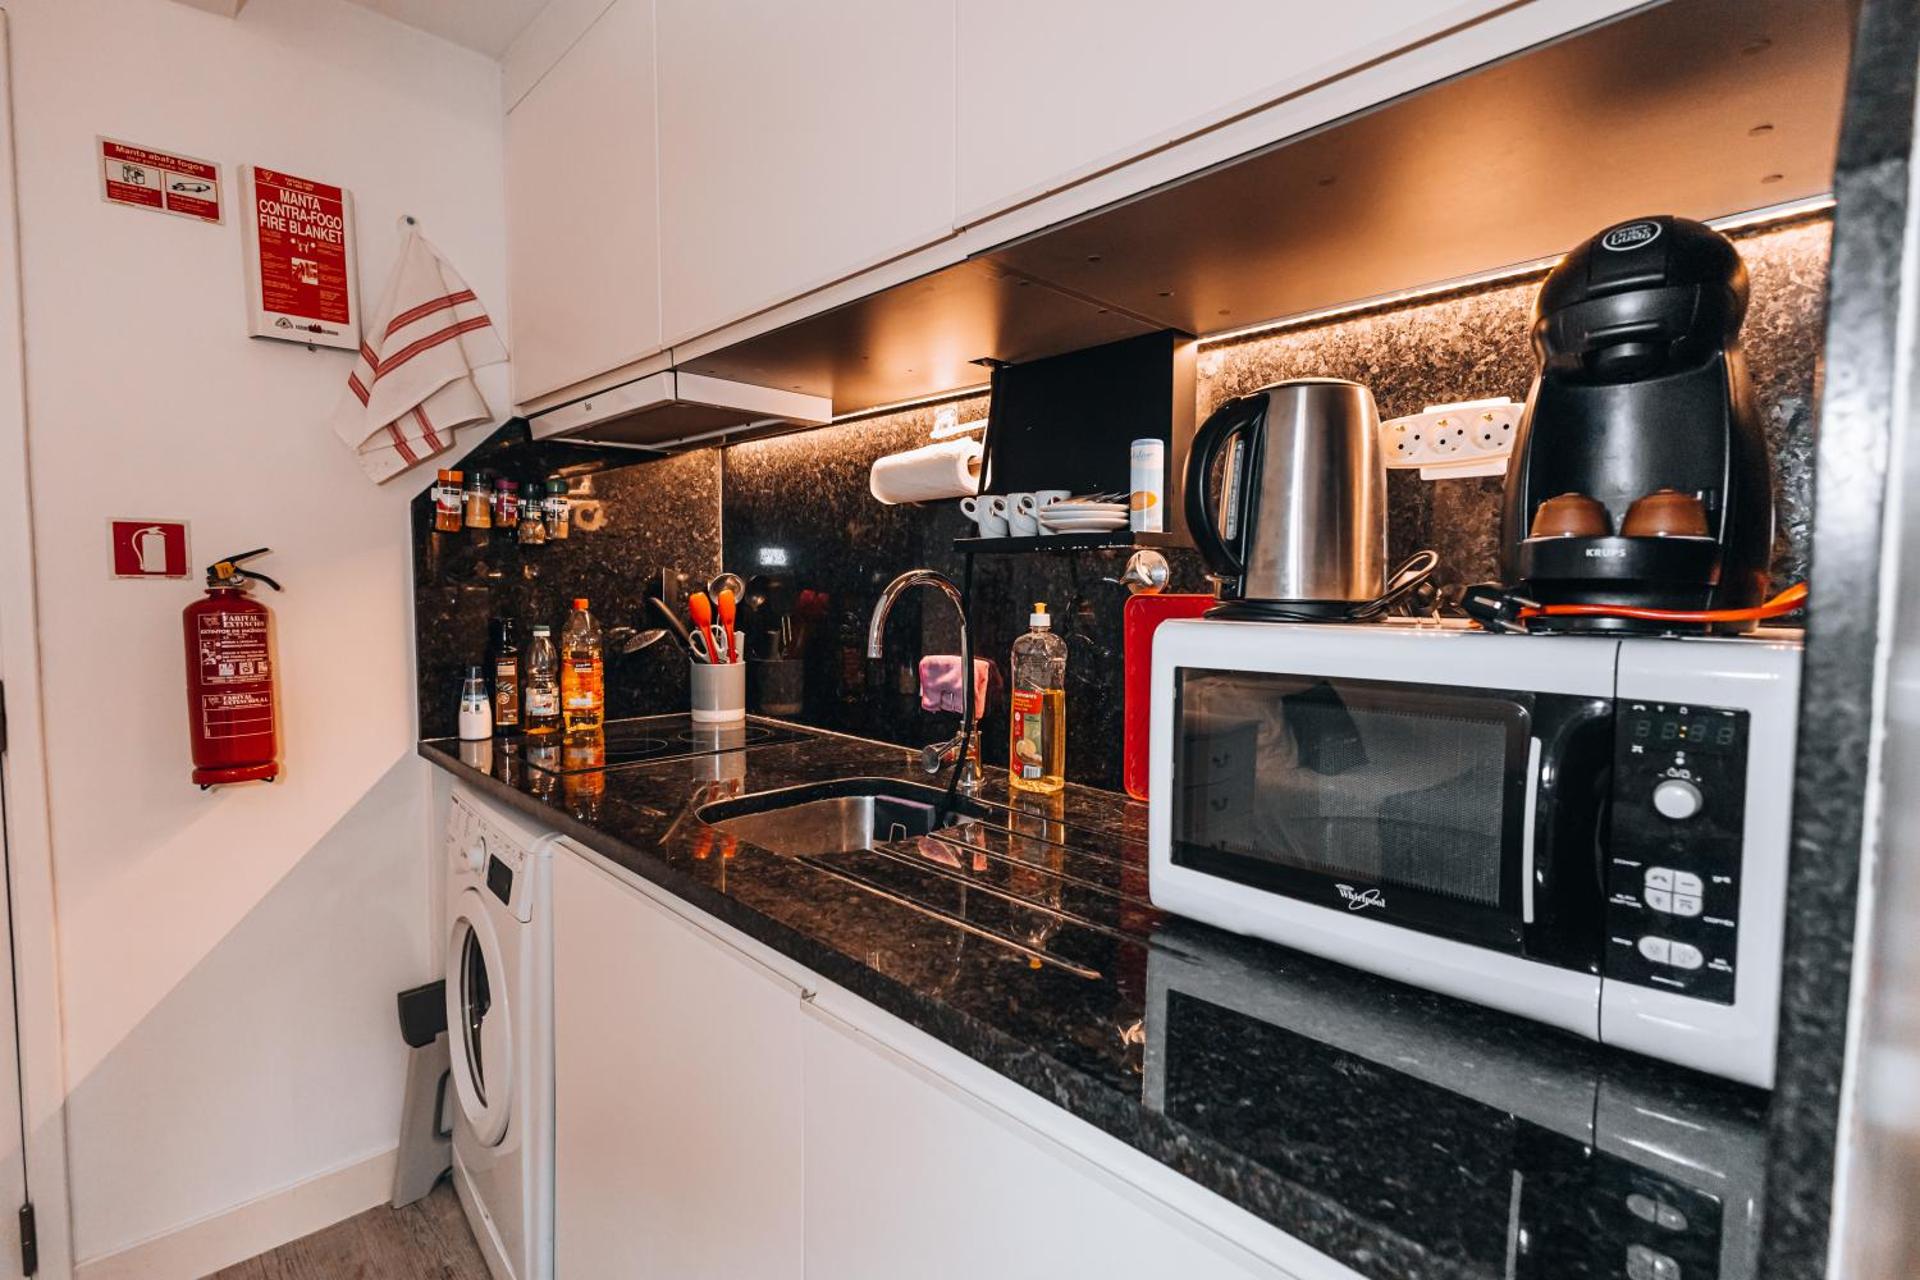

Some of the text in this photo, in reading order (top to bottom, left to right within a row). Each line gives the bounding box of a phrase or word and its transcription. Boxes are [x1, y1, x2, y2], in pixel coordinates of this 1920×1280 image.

[115, 145, 146, 158] Manta
[177, 159, 205, 172] fogos
[280, 189, 321, 211] MANTA
[259, 199, 342, 230] CONTRA-FOGO
[260, 214, 287, 232] FIRE
[289, 220, 343, 244] BLANKET
[1585, 548, 1627, 557] KRUPS
